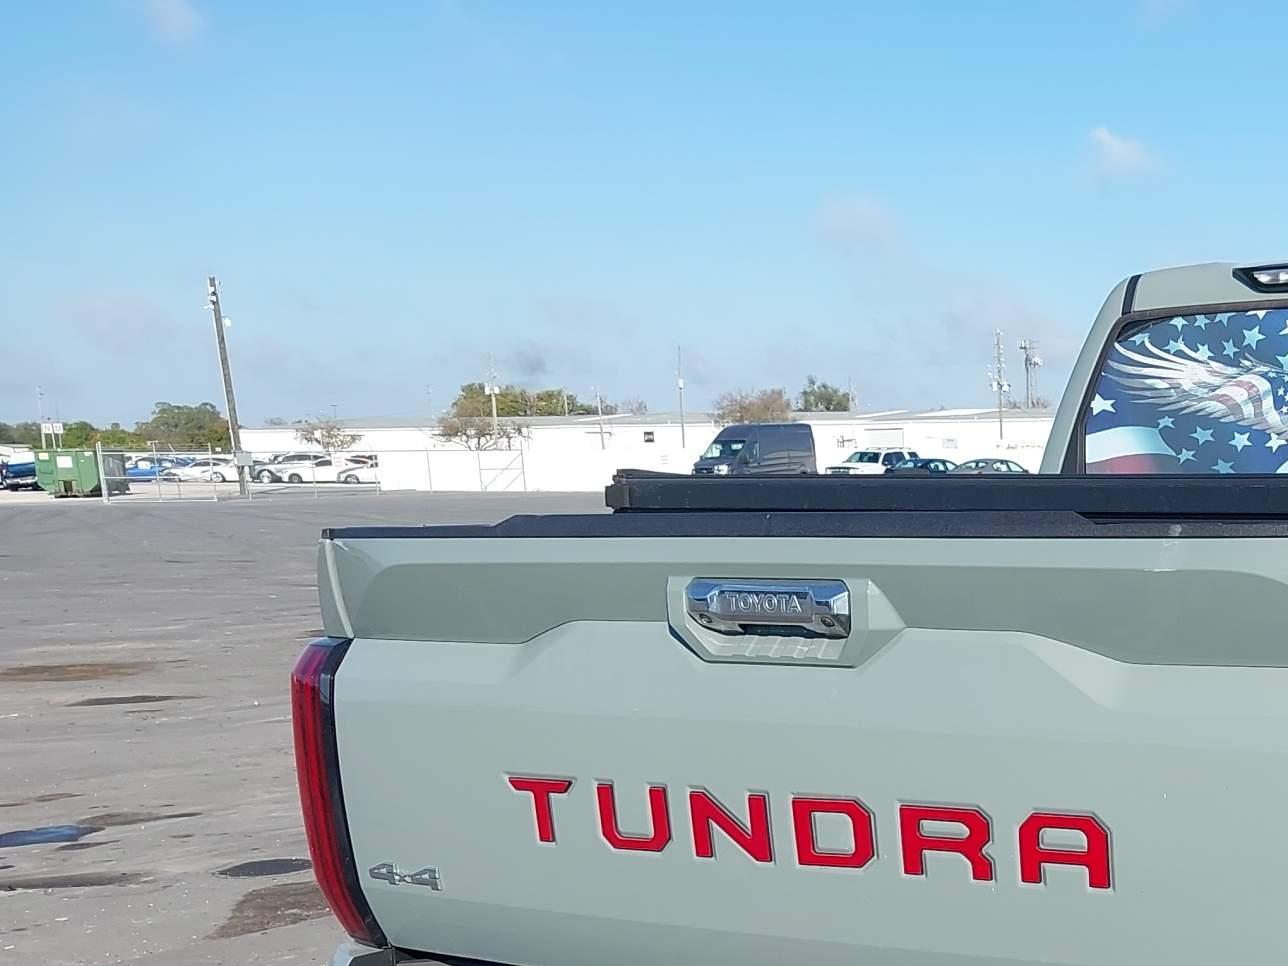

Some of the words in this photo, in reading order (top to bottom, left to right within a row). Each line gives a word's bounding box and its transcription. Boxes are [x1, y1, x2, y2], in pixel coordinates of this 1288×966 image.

[725, 592, 802, 613] TOYOTA
[505, 773, 1114, 891] TUNDRA
[368, 863, 443, 892] 4x4
